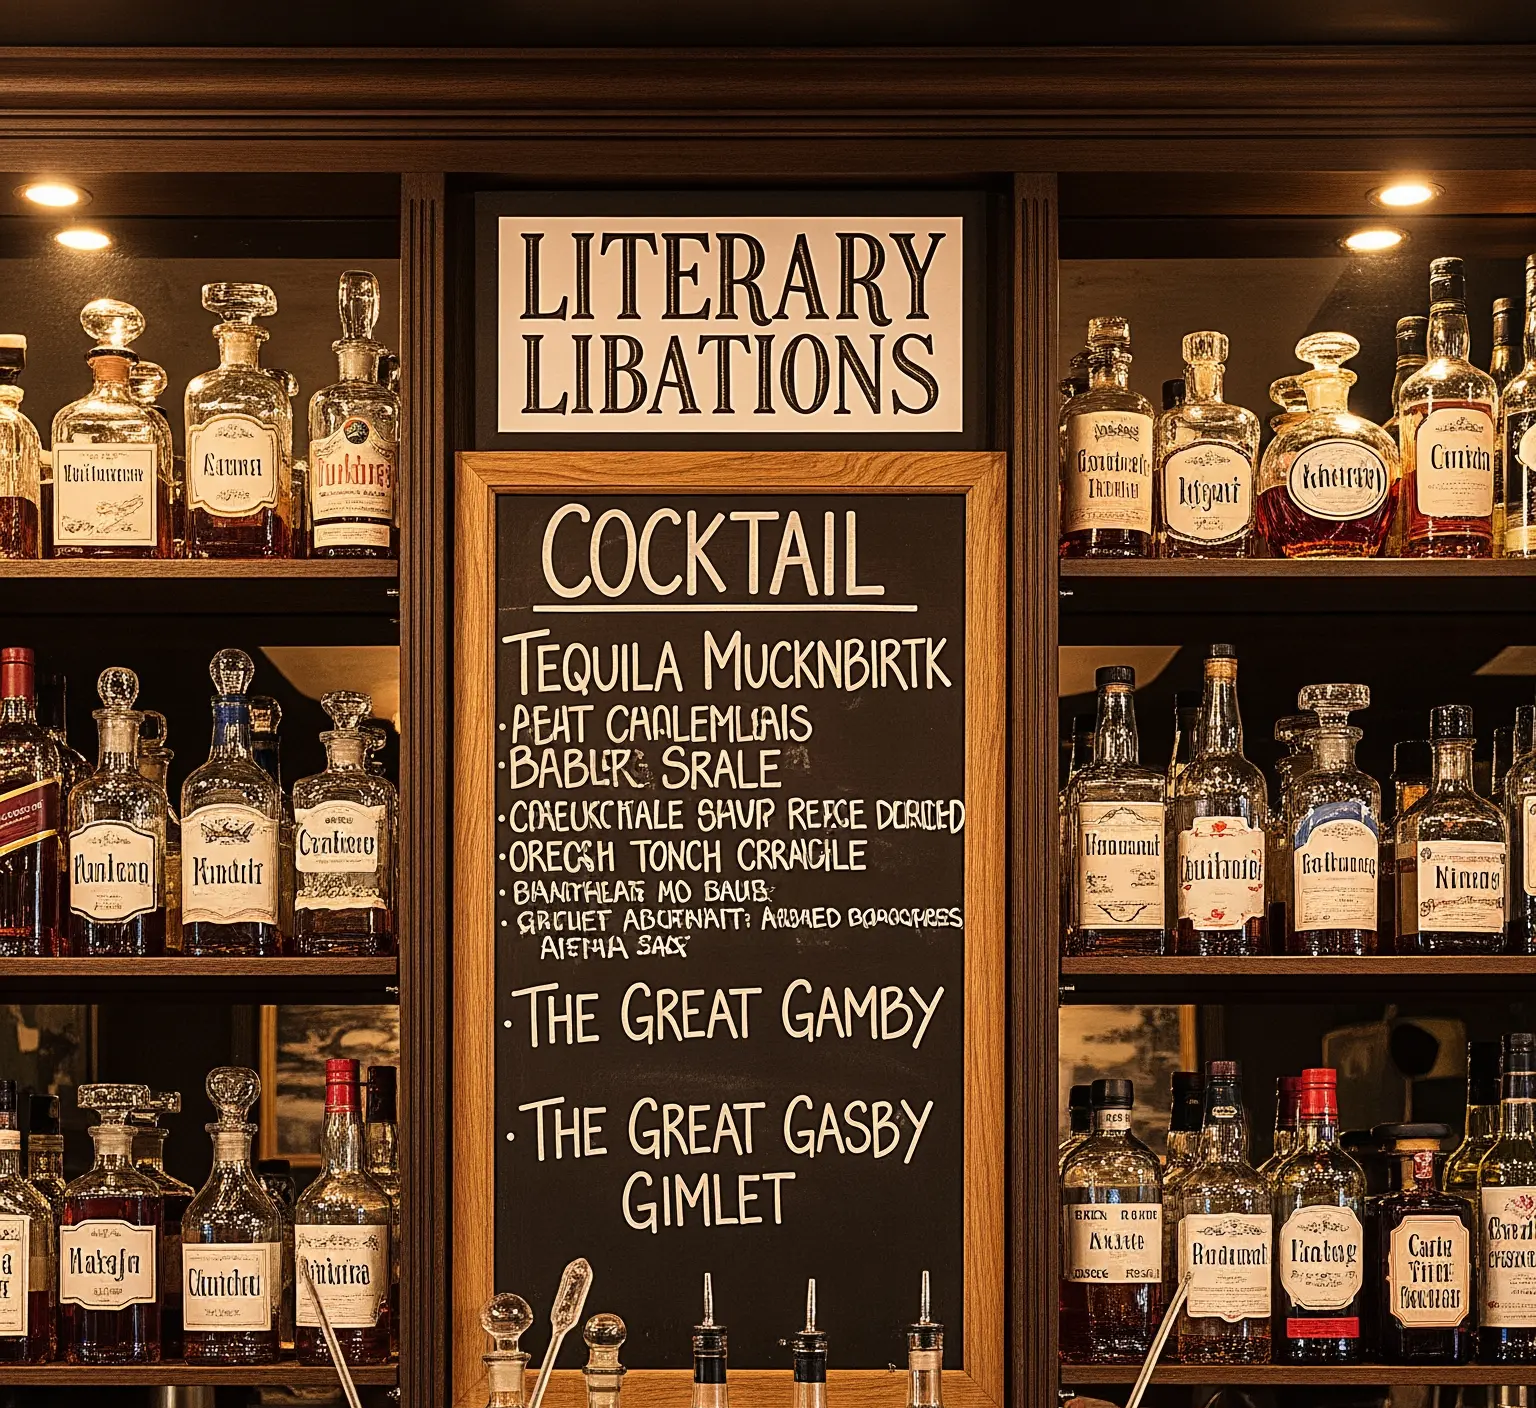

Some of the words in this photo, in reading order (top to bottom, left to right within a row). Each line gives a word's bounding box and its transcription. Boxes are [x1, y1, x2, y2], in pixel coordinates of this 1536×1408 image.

[519, 232, 947, 327] LITERARY
[521, 333, 940, 416] LIBATIONS
[541, 503, 885, 599] COCKTAIL
[501, 628, 684, 697] TEQUILA
[704, 630, 952, 692] MUCKNBIRTK
[661, 745, 782, 791] SRALE
[629, 839, 722, 874] TONCH
[658, 879, 692, 904] MO
[511, 982, 600, 1048] THE
[621, 982, 763, 1045] GREAT
[781, 978, 945, 1050] GAMBY
[518, 1096, 608, 1162] THE
[628, 1097, 766, 1160] GREAT
[783, 1094, 934, 1165] GASBY
[622, 1170, 796, 1234] GIMLET
